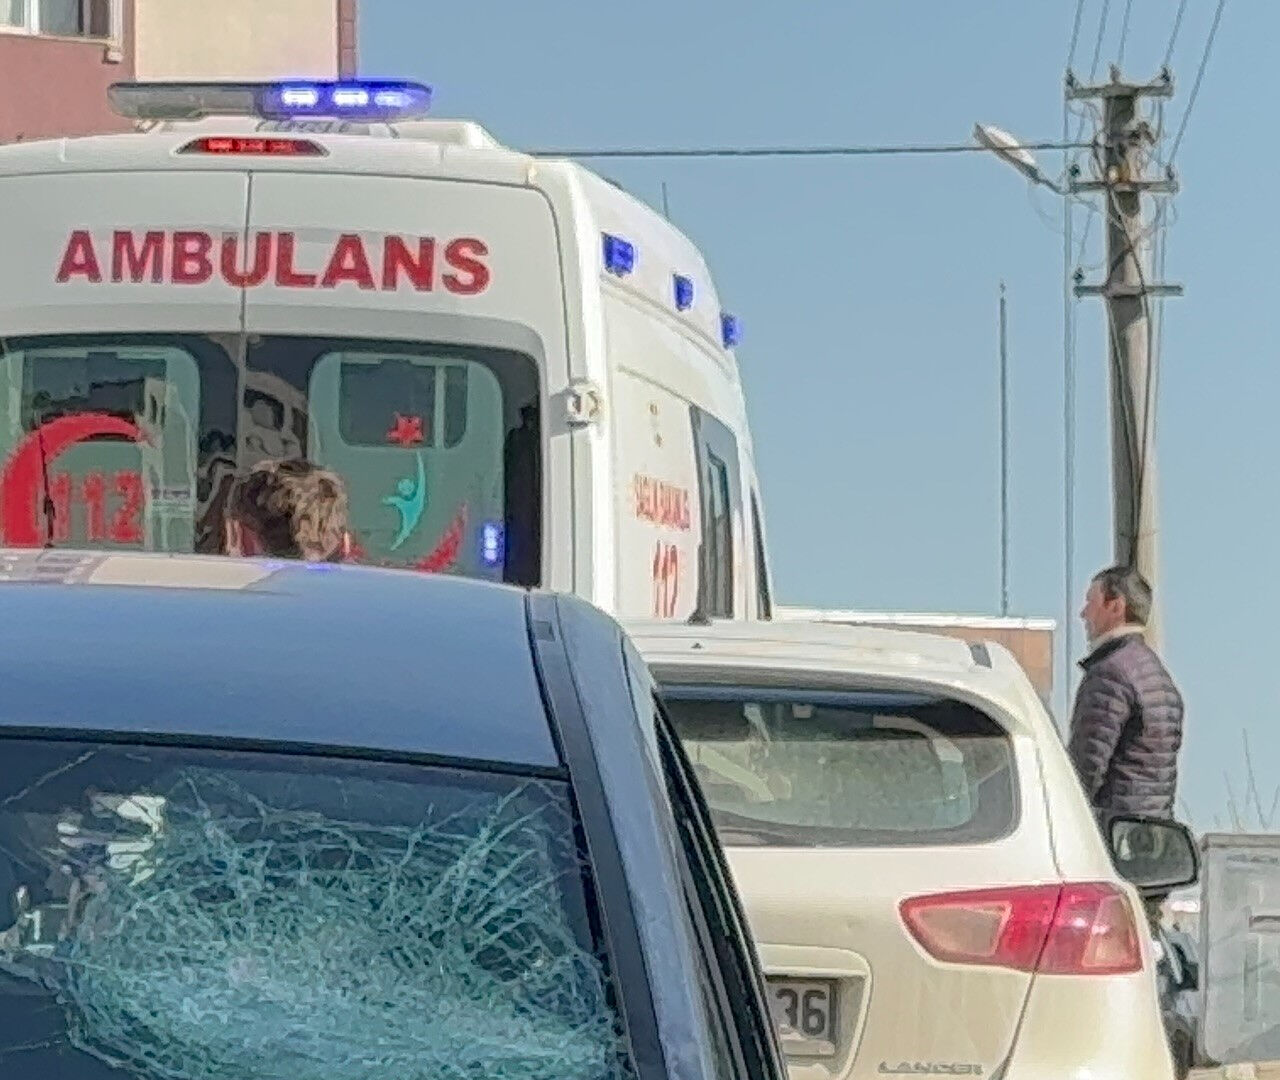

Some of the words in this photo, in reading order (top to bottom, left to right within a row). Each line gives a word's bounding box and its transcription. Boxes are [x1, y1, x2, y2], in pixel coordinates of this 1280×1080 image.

[55, 230, 491, 296] AMBULANS
[51, 470, 145, 542] 112
[775, 987, 827, 1037] 36
